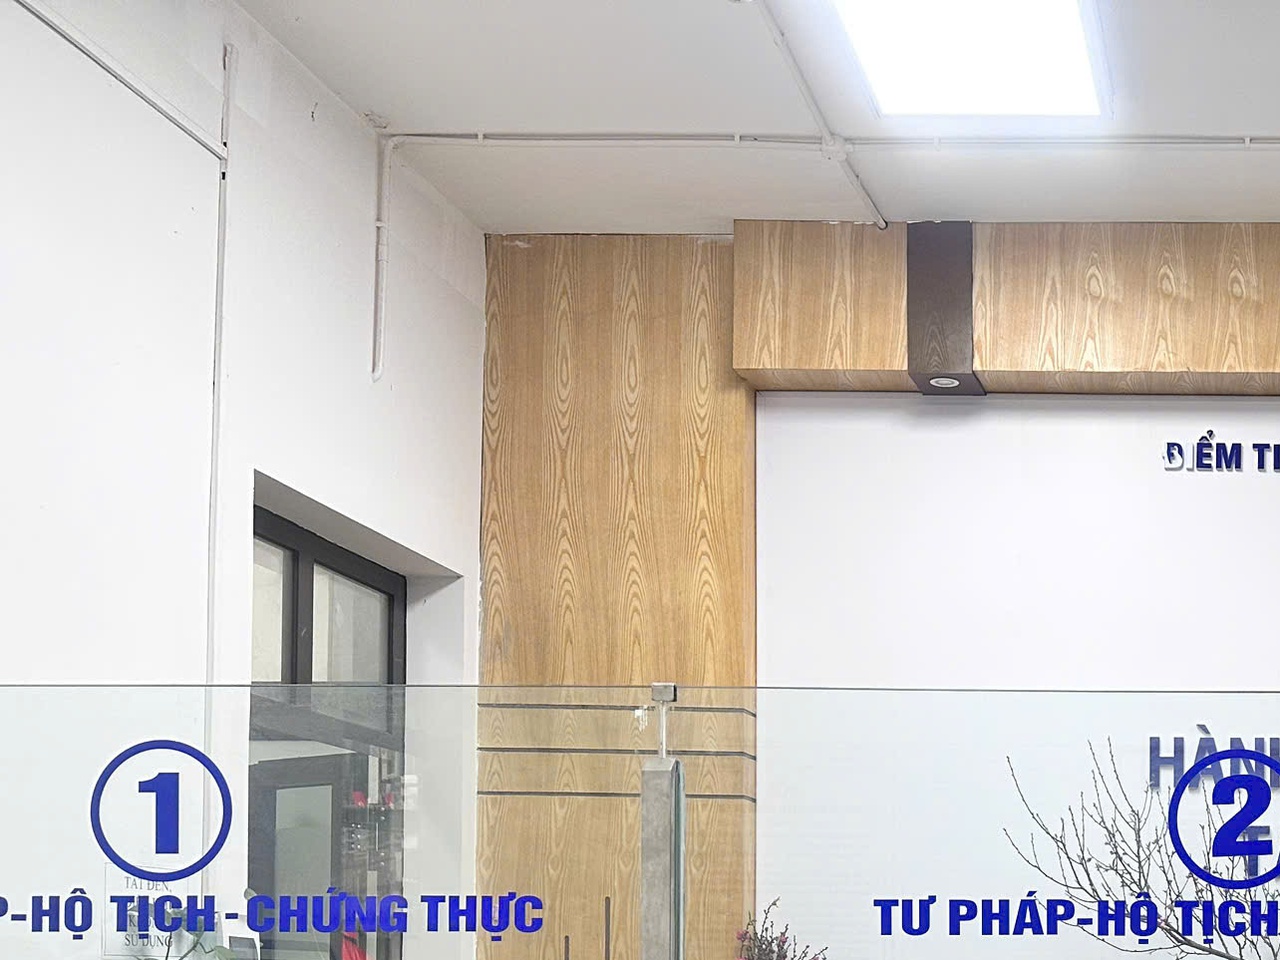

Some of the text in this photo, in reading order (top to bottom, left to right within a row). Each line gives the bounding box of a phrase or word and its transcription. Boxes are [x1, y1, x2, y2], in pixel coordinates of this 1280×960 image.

[1163, 429, 1244, 472] ĐIỂM
[138, 771, 180, 854] 1
[1212, 774, 1274, 857] 2
[420, 891, 544, 942] THỰC
[873, 895, 937, 936] TƯ
